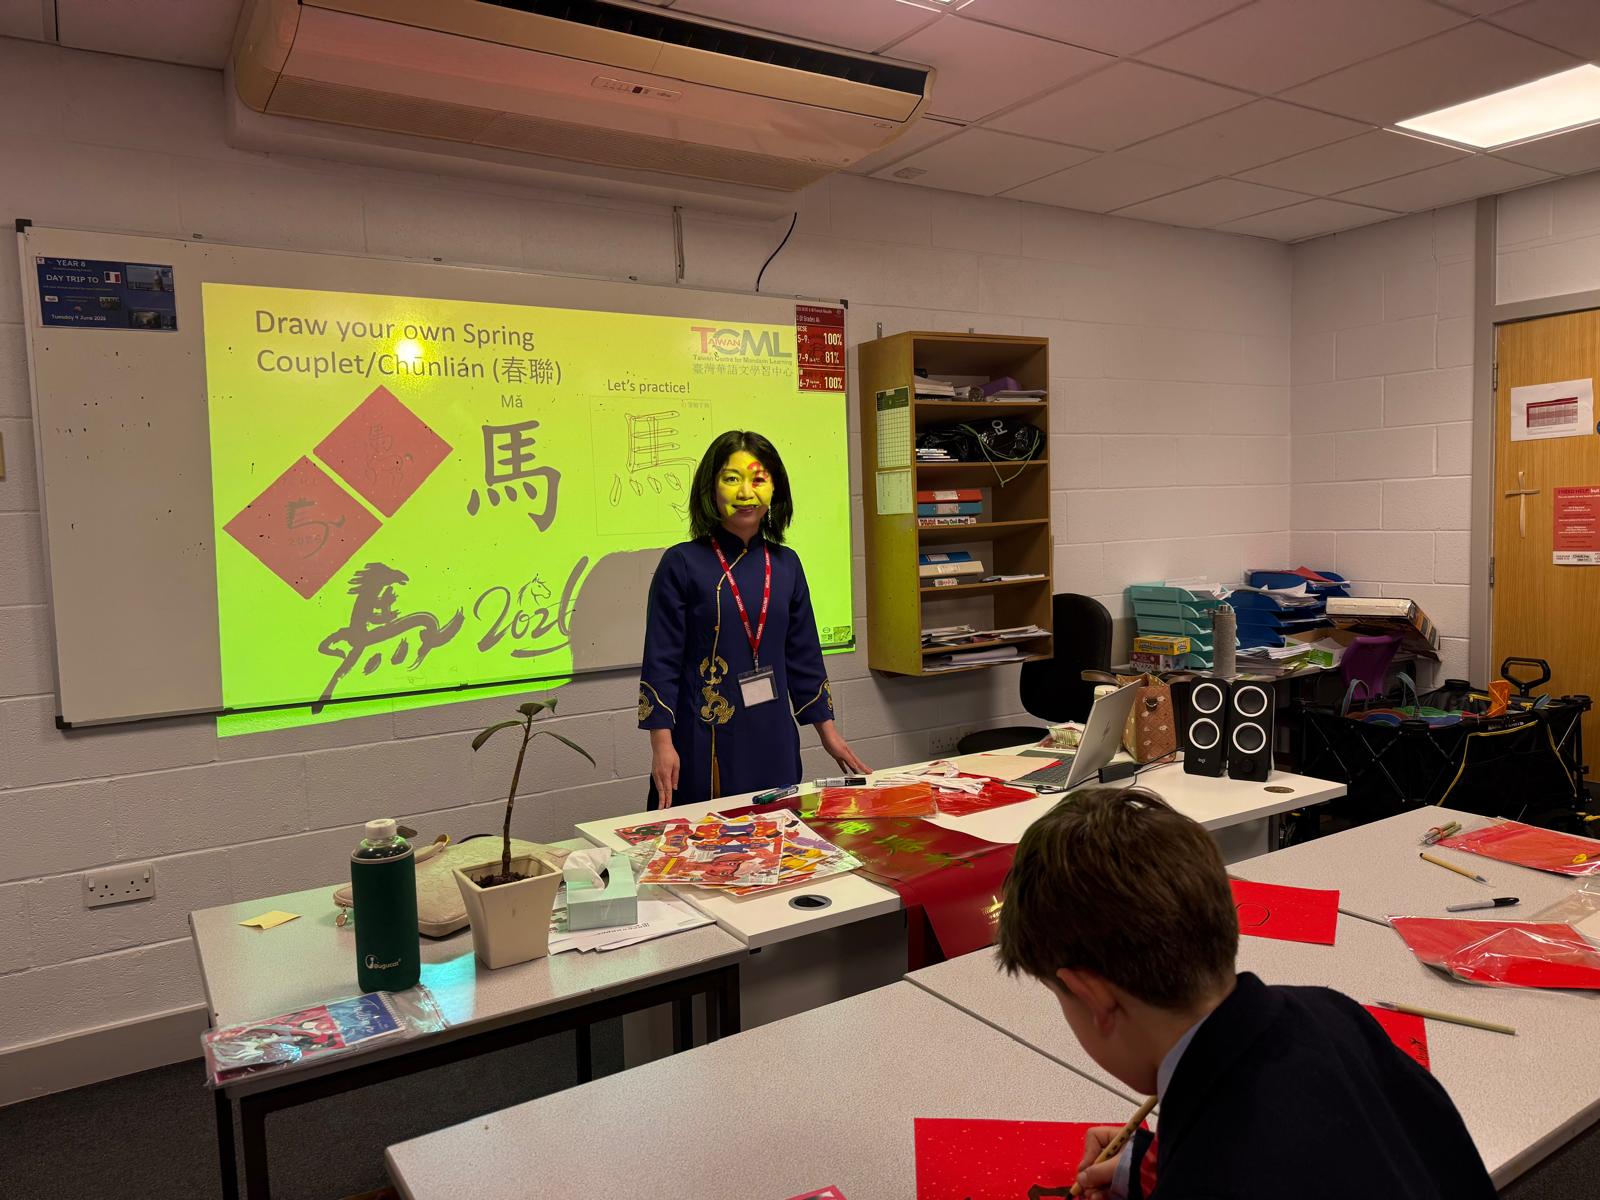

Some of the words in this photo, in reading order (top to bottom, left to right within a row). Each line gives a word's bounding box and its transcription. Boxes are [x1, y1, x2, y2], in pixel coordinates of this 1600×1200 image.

[56, 259, 79, 267] YEAR
[66, 275, 86, 283] TRIP
[256, 310, 328, 335] Draw
[336, 320, 395, 342] your
[403, 324, 455, 342] own
[463, 323, 535, 352] Spring
[824, 333, 842, 346] 100%
[770, 358, 793, 366] Learning
[825, 351, 840, 364] 81%
[493, 357, 562, 386] (春聯)
[639, 381, 690, 394] practice!
[824, 376, 843, 390] 100%
[467, 420, 561, 533] 馬
